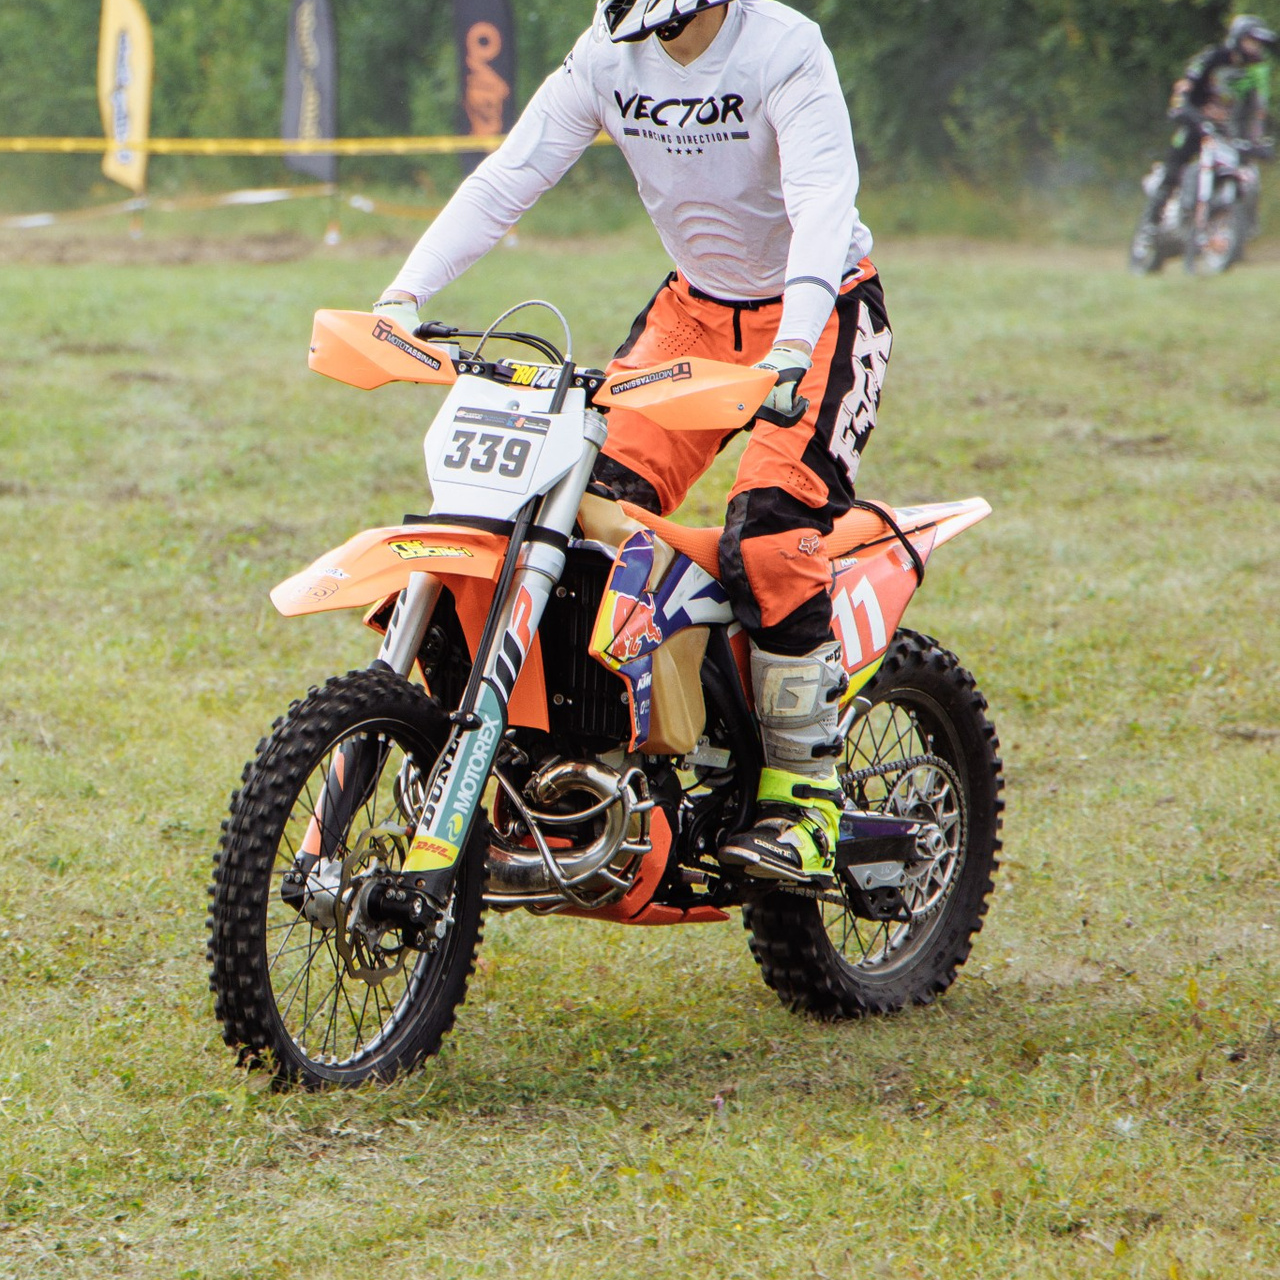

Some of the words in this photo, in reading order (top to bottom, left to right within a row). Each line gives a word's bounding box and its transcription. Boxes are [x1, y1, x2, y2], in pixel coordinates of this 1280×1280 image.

[613, 89, 745, 129] VECTOR
[642, 128, 672, 144] RACING
[676, 131, 730, 145] DIRECTION
[386, 333, 441, 371] MOTOTASSINARI
[612, 369, 673, 394] MOTOTASSINARI
[443, 429, 532, 479] 339
[452, 714, 500, 815] MOTOREX
[415, 840, 452, 859] DHL
